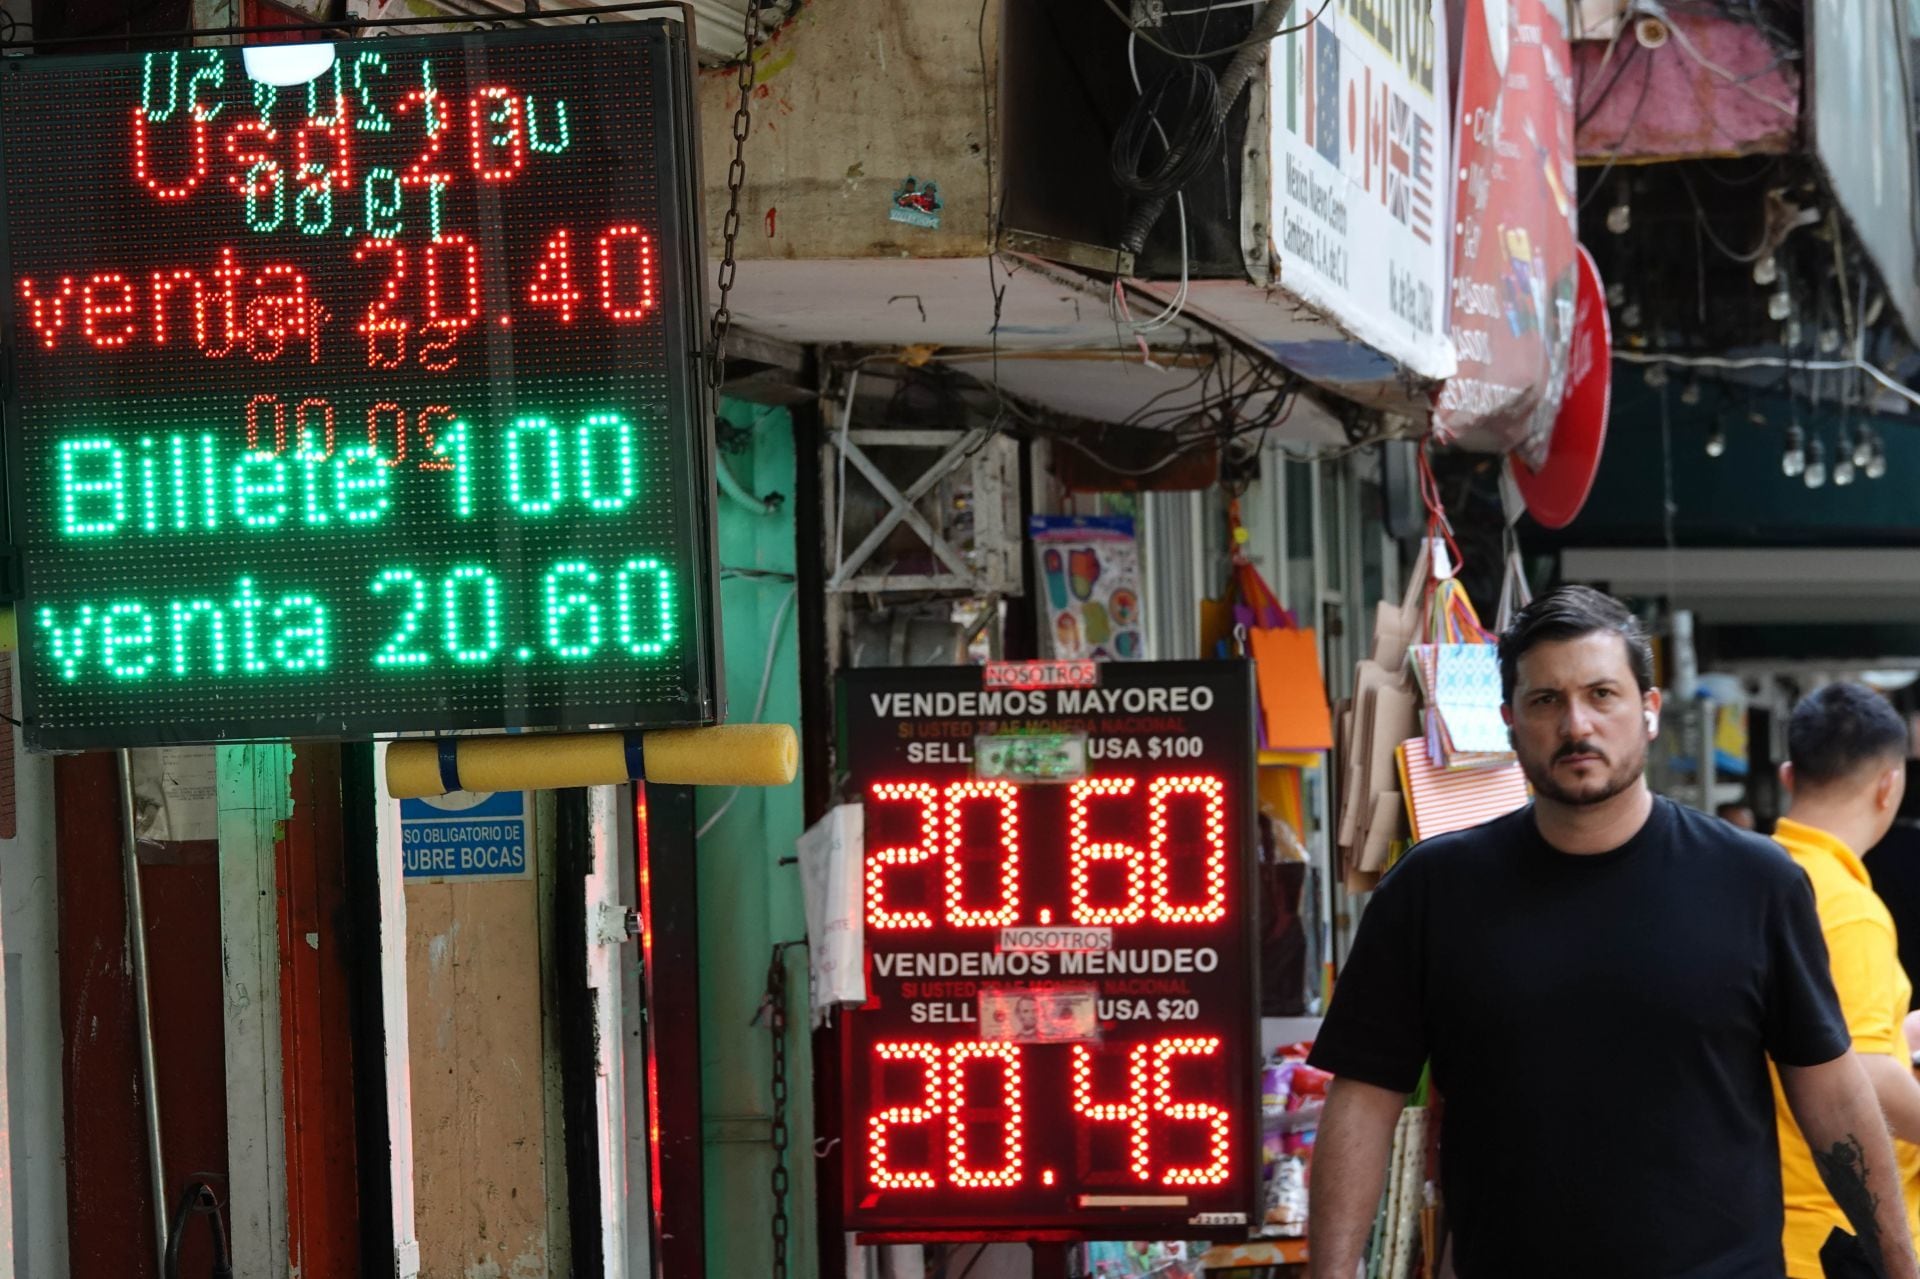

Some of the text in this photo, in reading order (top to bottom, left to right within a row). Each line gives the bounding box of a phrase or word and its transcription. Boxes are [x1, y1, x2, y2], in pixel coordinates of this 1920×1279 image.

[134, 86, 523, 199] Usd 20
[18, 224, 657, 350] venta 20.40
[56, 410, 638, 536] Billete 100
[38, 556, 677, 681] venta 20.60
[988, 664, 1095, 685] NOSOTROS
[871, 686, 1214, 717] VENDEMOS MAYOREO
[918, 719, 972, 738] USTED
[1102, 714, 1186, 733] NACIONAL
[906, 736, 1204, 763] SELL USA $100
[402, 825, 520, 844] SO OBLIGATORIO DE
[461, 846, 523, 869] BOCAS
[865, 774, 1227, 930] 20.60
[1003, 930, 1111, 950] NOSOTROS
[874, 948, 1219, 977] VENDEMOS MENUDEO
[921, 980, 976, 998] USTED
[910, 999, 1200, 1023] SELL USA $20
[868, 1036, 1231, 1189] 20.45
